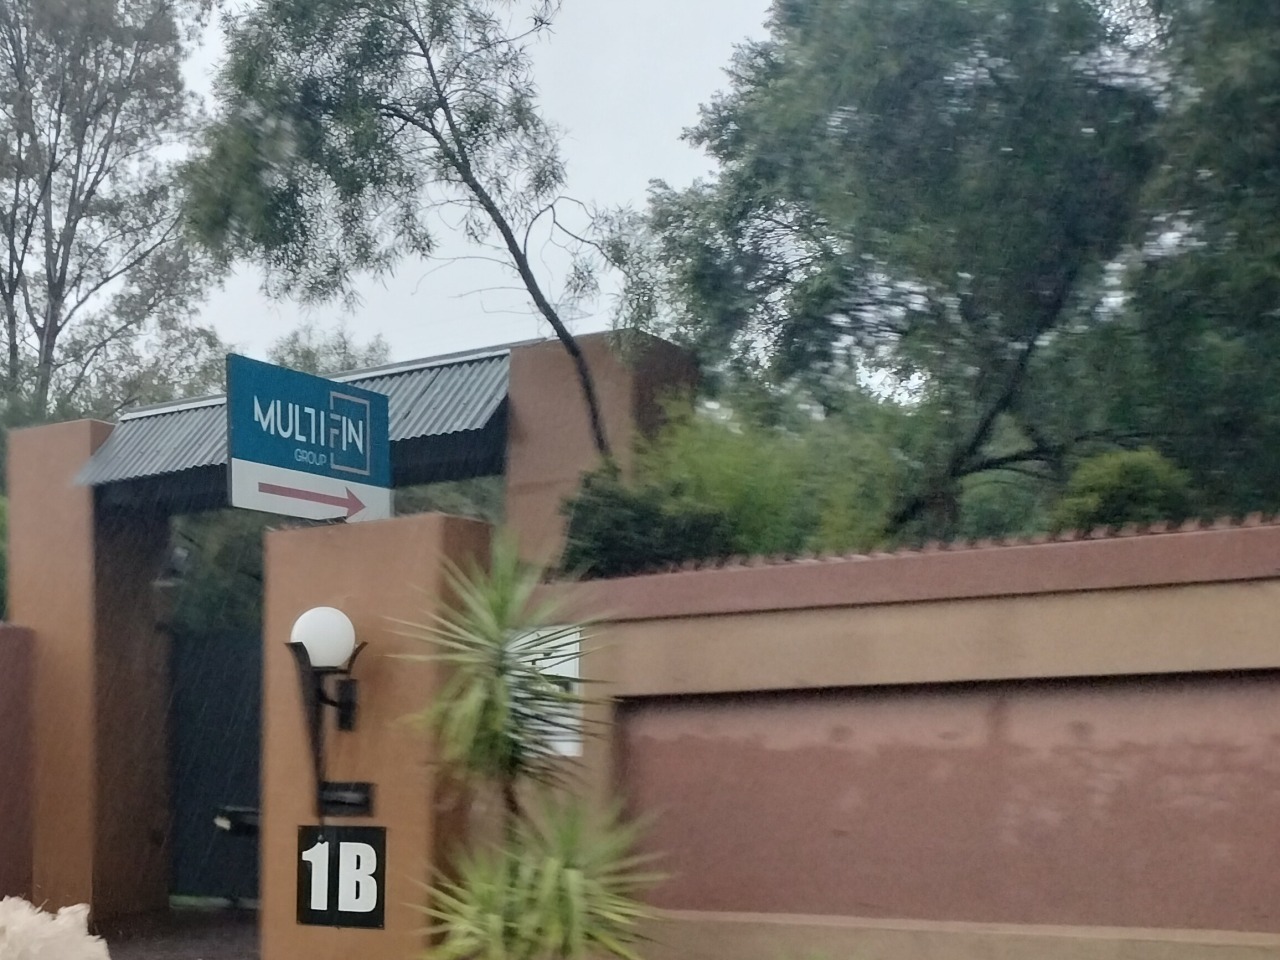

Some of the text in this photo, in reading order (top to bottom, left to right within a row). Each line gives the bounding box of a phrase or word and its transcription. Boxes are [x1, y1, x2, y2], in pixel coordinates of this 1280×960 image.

[254, 395, 363, 454] MULTIFIN
[294, 448, 327, 465] GROUP
[302, 841, 377, 912] 1B
